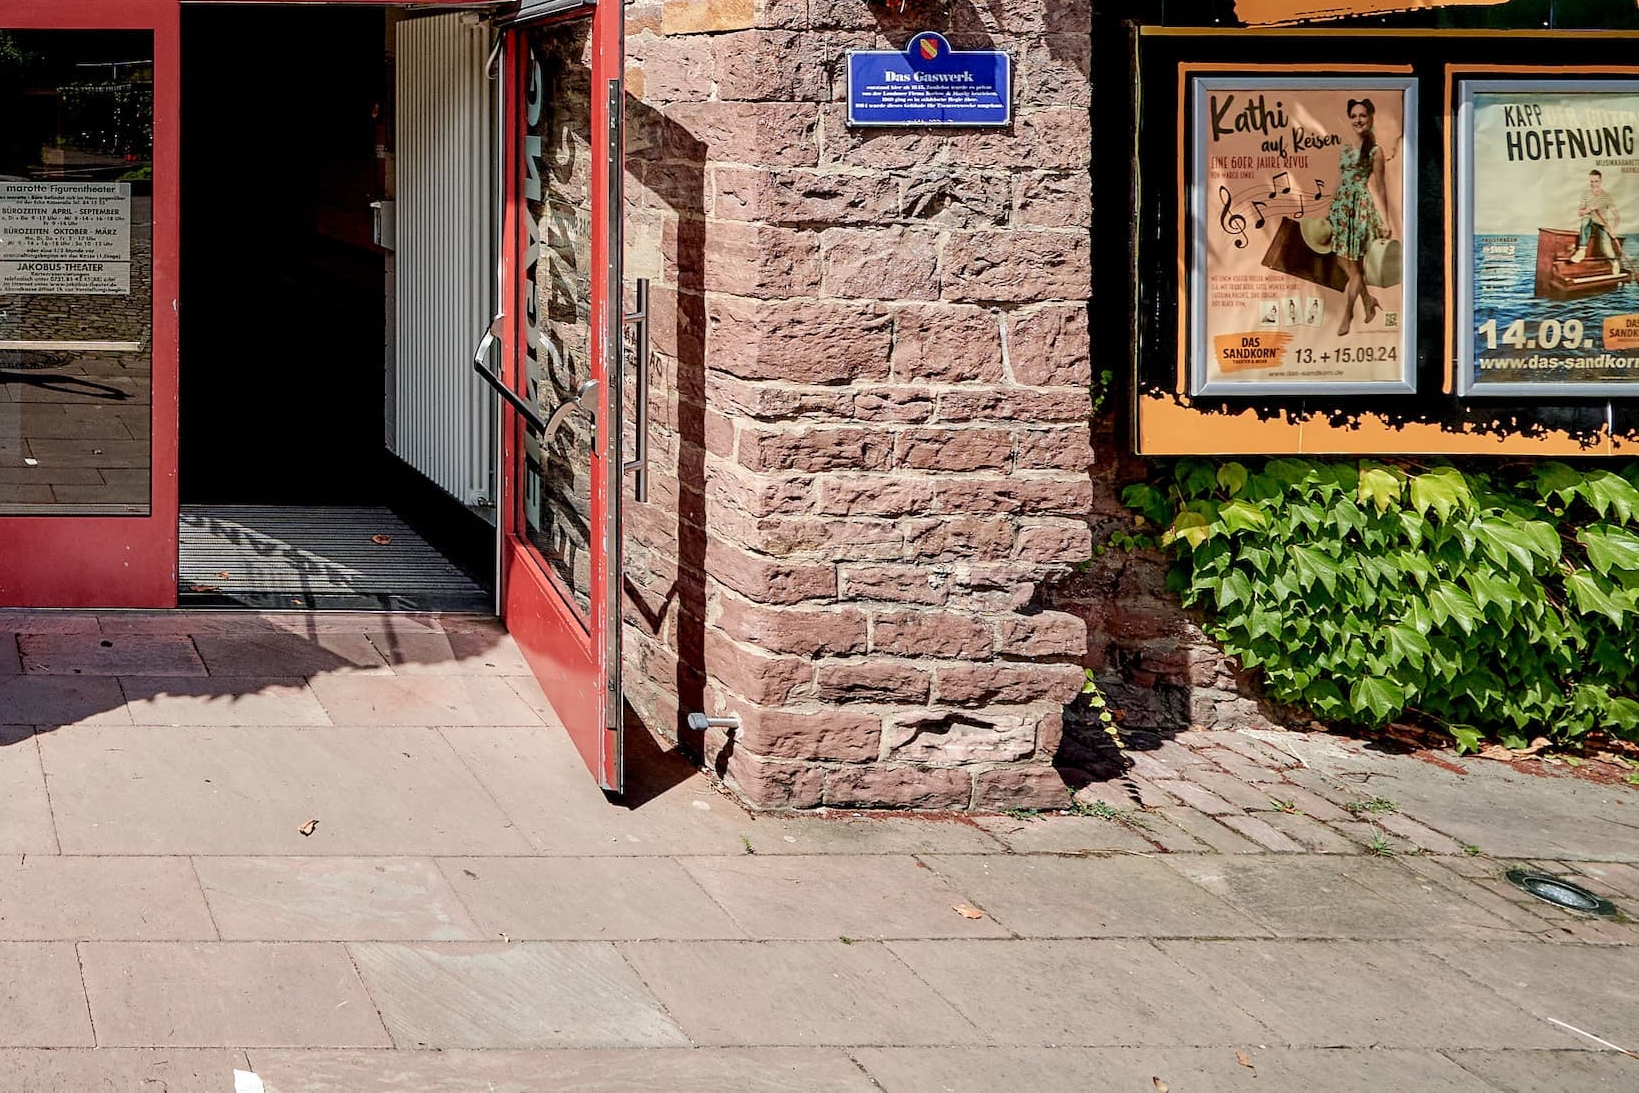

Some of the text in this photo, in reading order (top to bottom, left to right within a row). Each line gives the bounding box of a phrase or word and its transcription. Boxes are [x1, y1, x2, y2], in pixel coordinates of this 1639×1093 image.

[884, 70, 974, 83] Das Gaswerk
[1211, 94, 1289, 142] Kathi
[1504, 104, 1542, 127] KAPP
[1261, 127, 1341, 158] auf Reisen
[1506, 125, 1634, 161] HOFFNUNG
[1284, 155, 1309, 169] REVUE
[6, 184, 116, 194] marotte Figurentheater
[2, 206, 47, 214] BÜROZEITEN
[4, 226, 49, 234] BÜROZEITEN
[53, 227, 87, 235] OKTOBER
[95, 226, 117, 235] MÄRZ
[17, 263, 104, 271] JAKOBUS-THEATER
[1478, 318, 1594, 350] 14.09.
[1241, 337, 1261, 348] DAS
[1223, 348, 1276, 359] SANDKORN
[1295, 346, 1398, 364] 13. + 15.09.24
